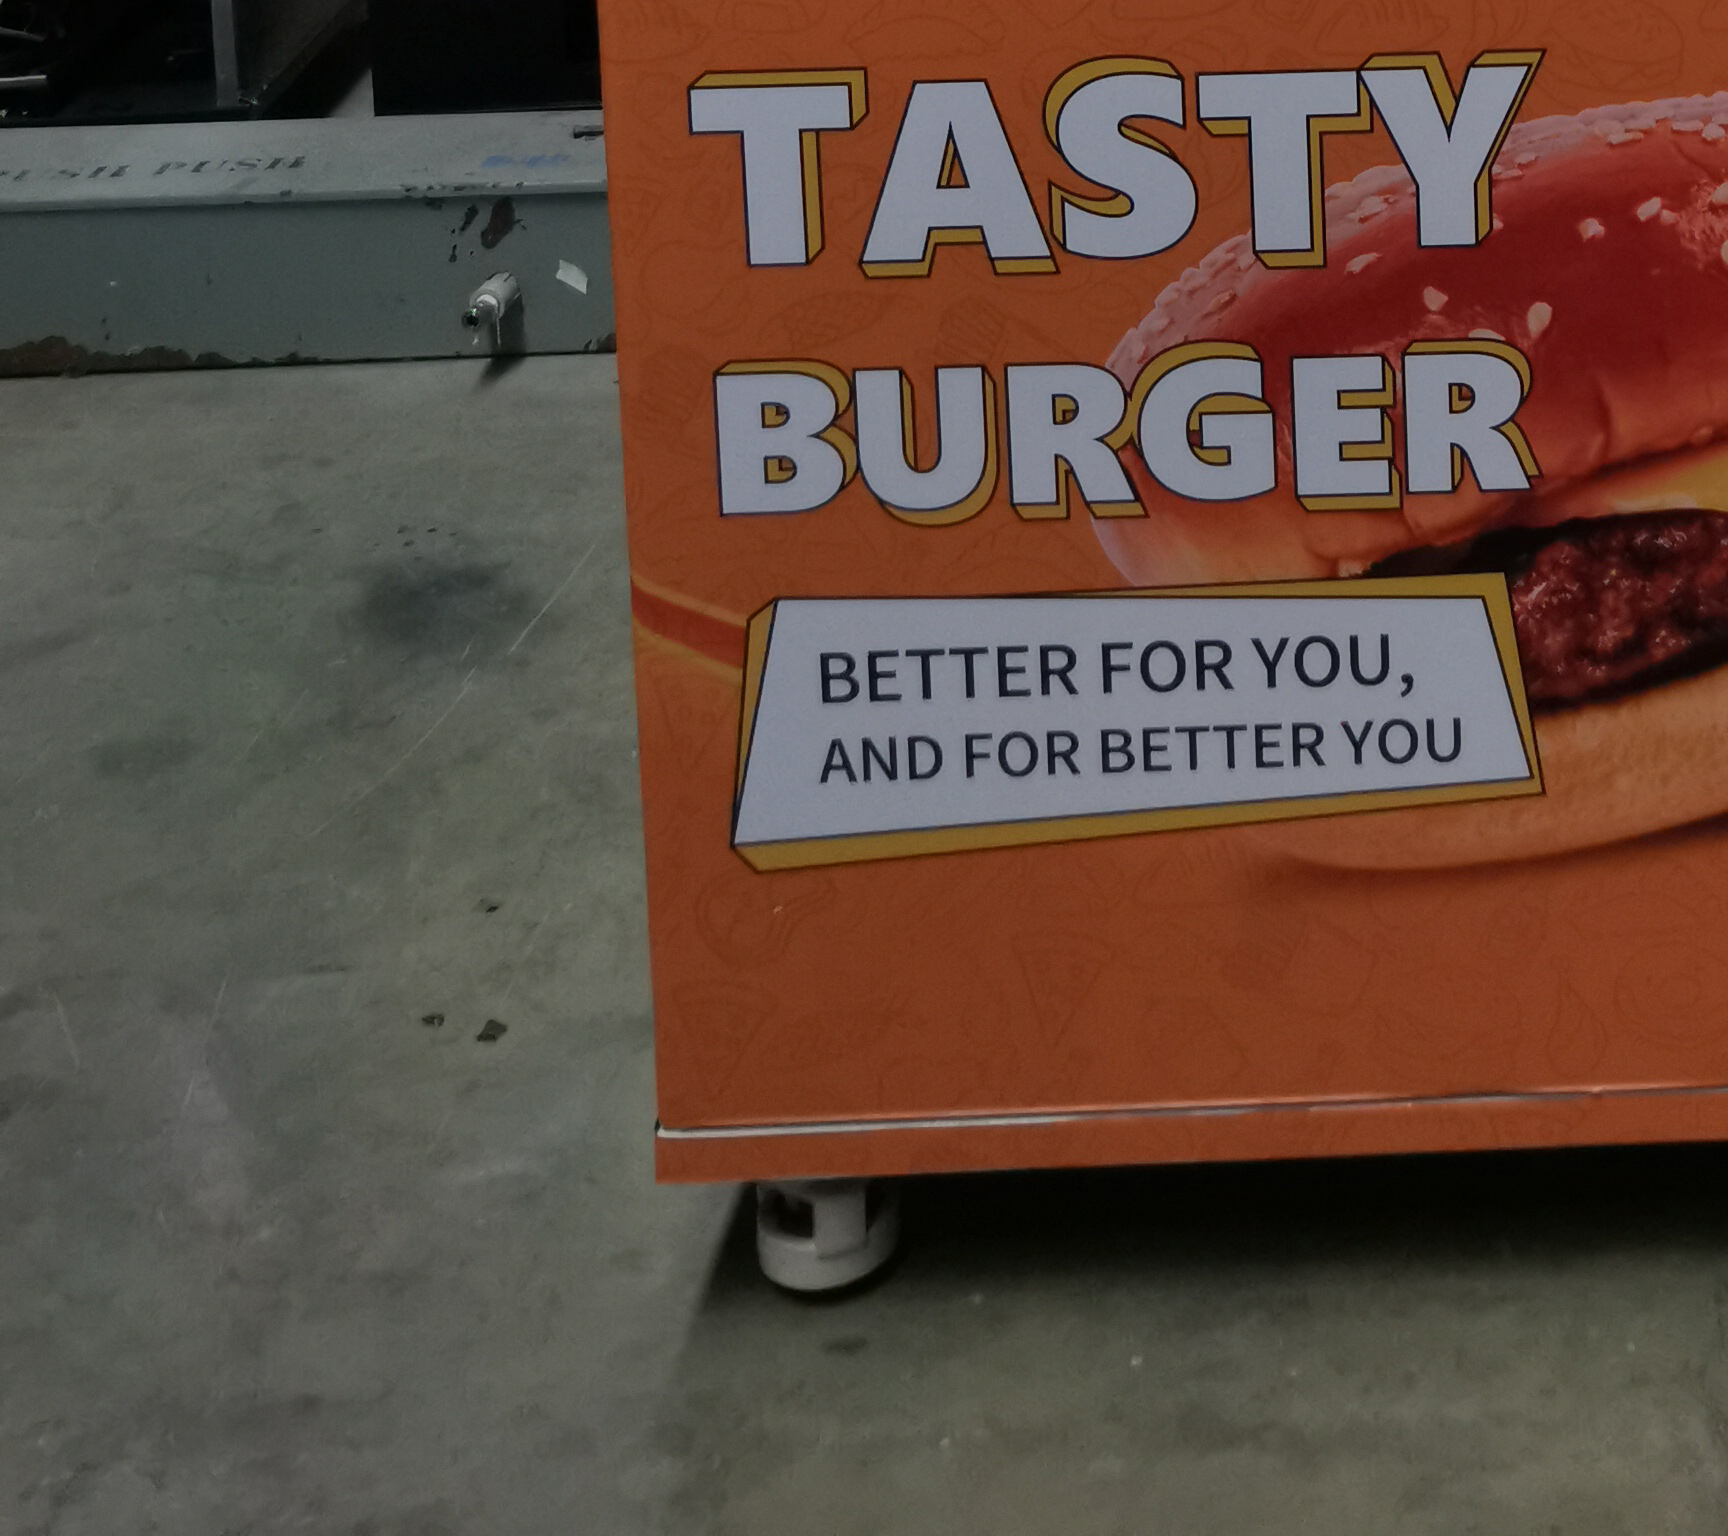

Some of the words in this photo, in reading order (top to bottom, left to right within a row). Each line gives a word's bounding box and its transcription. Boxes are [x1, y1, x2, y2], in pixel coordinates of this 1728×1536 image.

[688, 48, 1547, 279] TASTY
[714, 339, 1541, 526] BURGER
[818, 643, 1079, 704] BETTER
[1101, 638, 1235, 694] FOR
[1250, 633, 1415, 698] YOU,
[819, 734, 944, 784] AND
[964, 729, 1081, 778] FOR
[1100, 721, 1327, 774] BETTER
[1340, 716, 1463, 766] YOU
